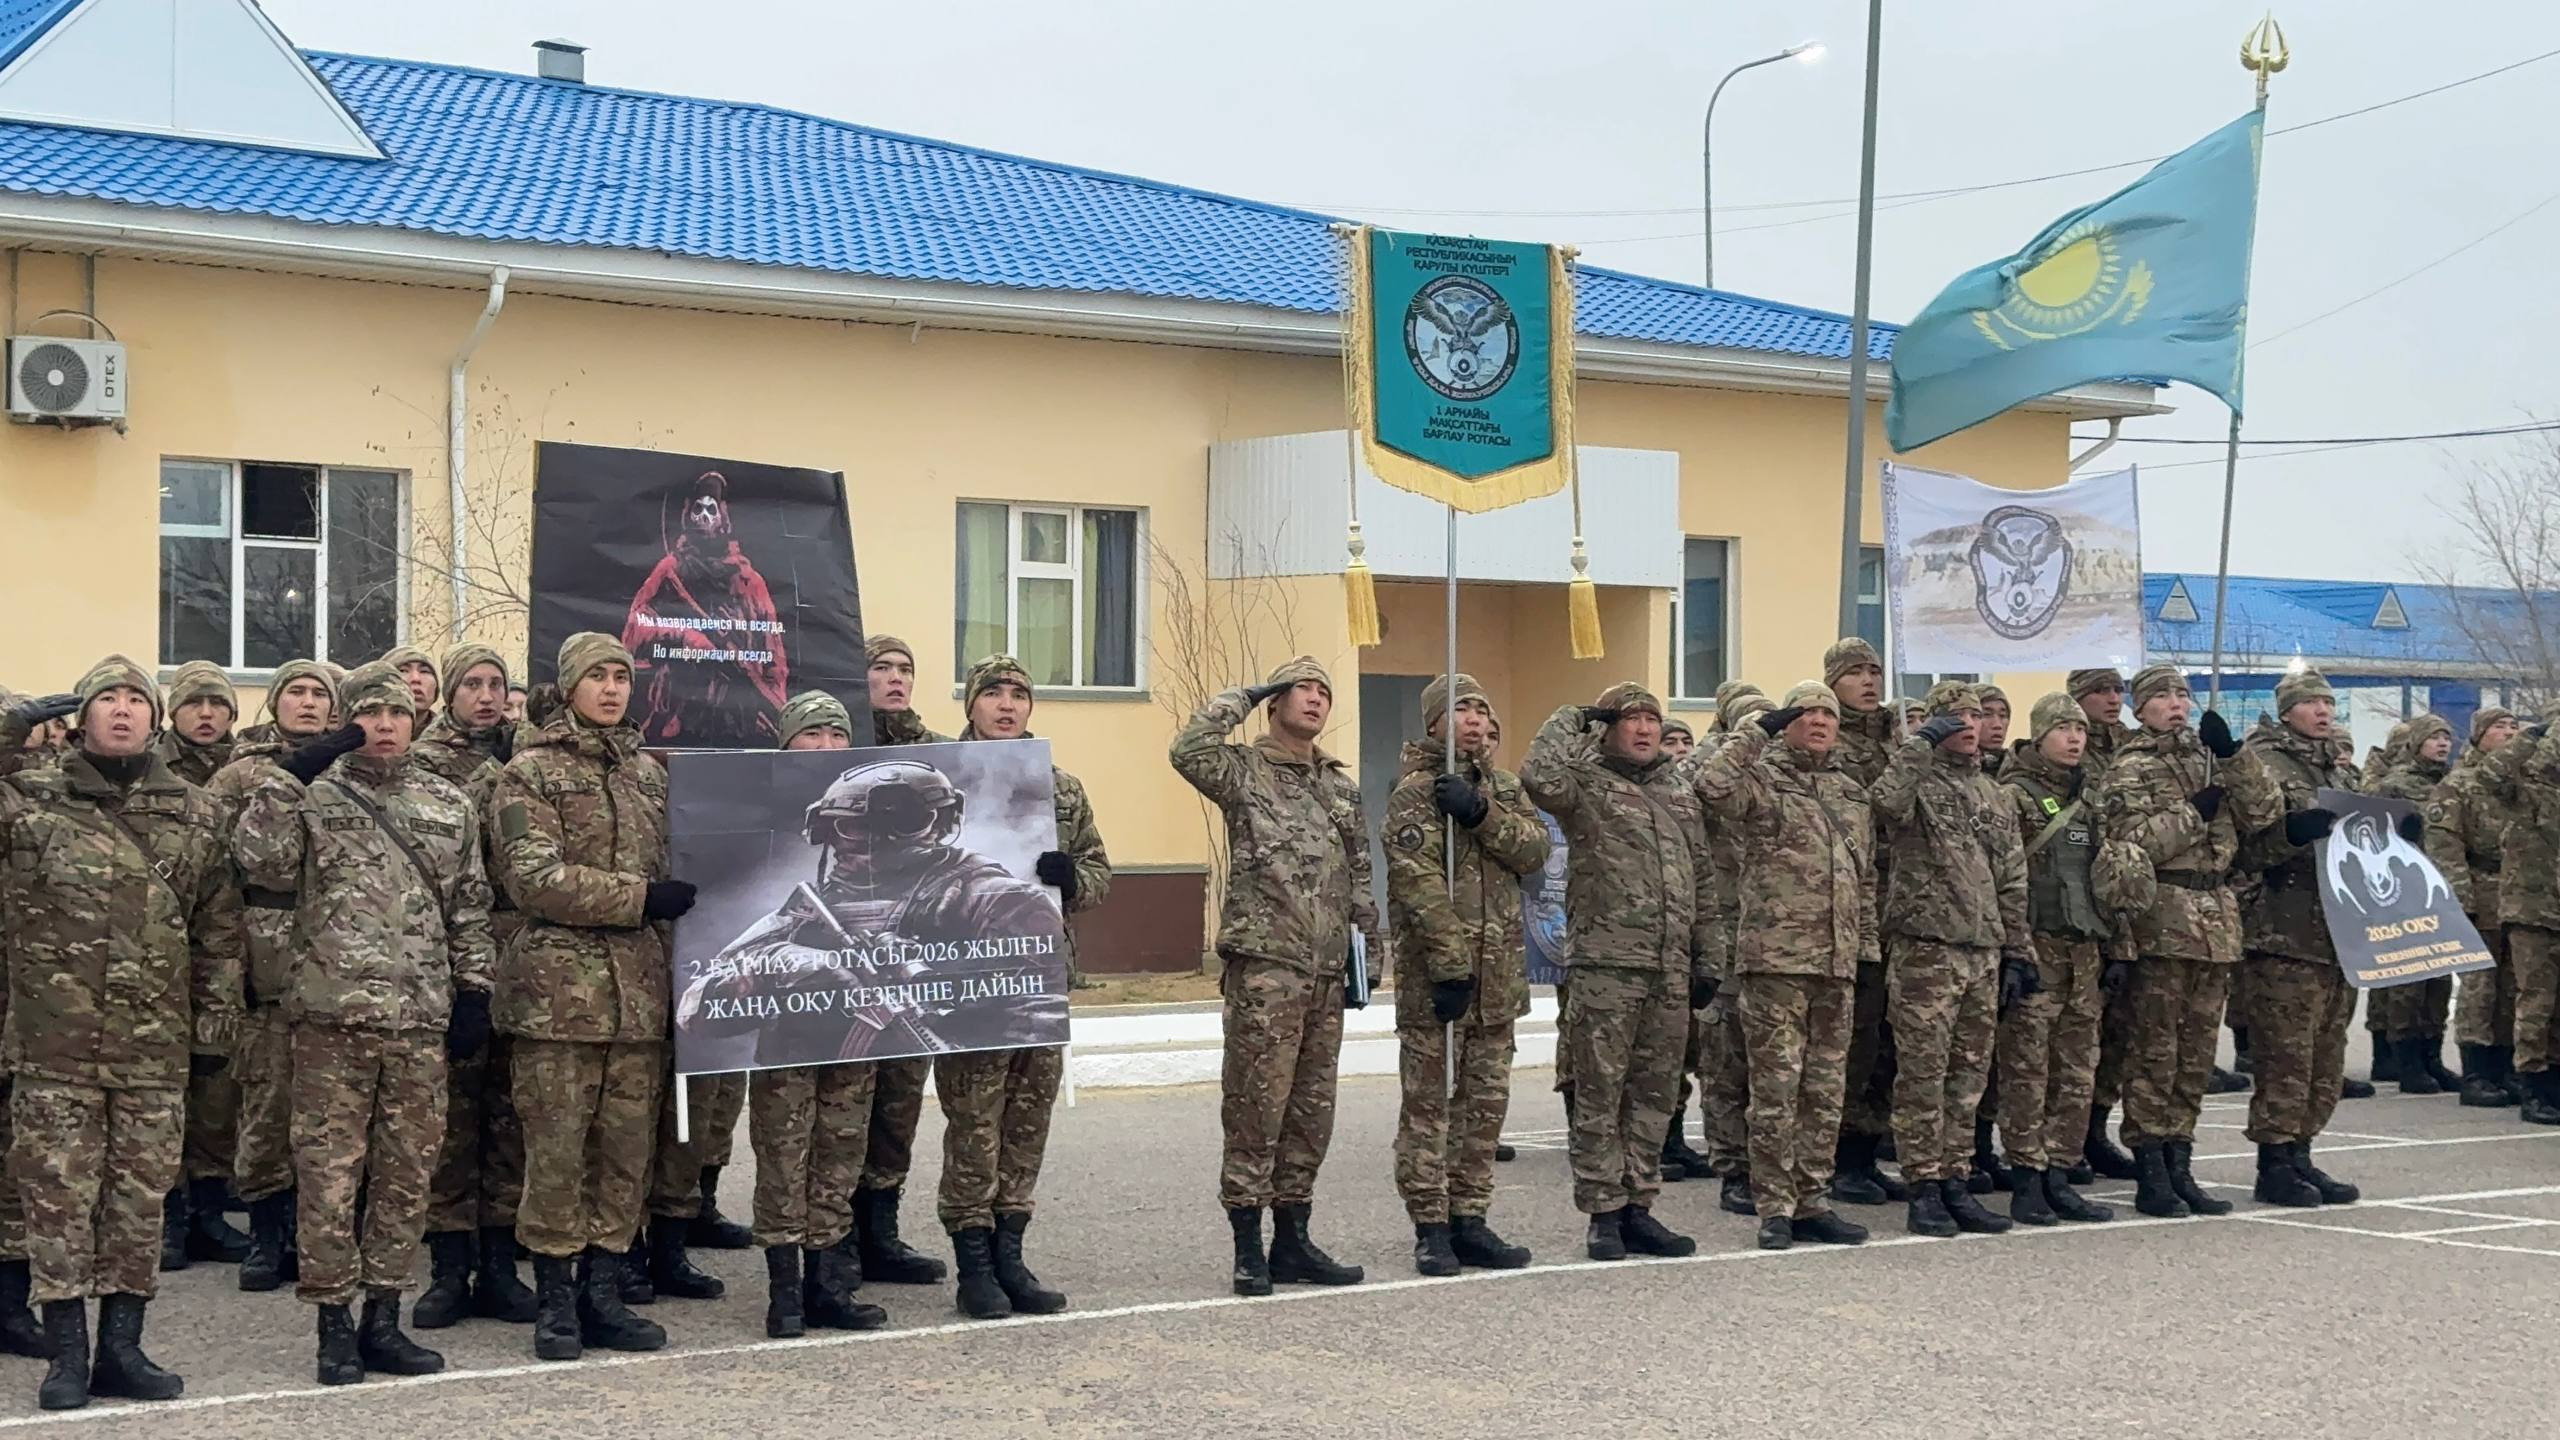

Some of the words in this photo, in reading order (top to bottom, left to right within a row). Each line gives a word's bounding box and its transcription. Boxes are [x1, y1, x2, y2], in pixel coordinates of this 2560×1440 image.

[105, 354, 115, 398] OTEX
[1444, 406, 1490, 420] АРНАЙЫ
[1423, 427, 1465, 441] БАРЛАУ
[1467, 433, 1512, 446] РОТАСЫ
[636, 612, 655, 627] Мы
[657, 616, 733, 632] возвращаемся
[735, 619, 748, 631] не
[750, 620, 786, 634] всегда.
[653, 643, 667, 659] Но
[669, 644, 735, 663] информация
[738, 649, 773, 663] всегда
[689, 959, 702, 980] 2
[709, 952, 804, 979] БАРЛАУ
[812, 943, 910, 971] РОТАСЫ
[910, 940, 959, 963] 2026
[963, 934, 1054, 960] ЖЫЛҒЫ
[704, 994, 781, 1020] ЖАҢА
[787, 990, 837, 1015] ОҚУ
[959, 972, 1046, 1003] ДАЙЫН
